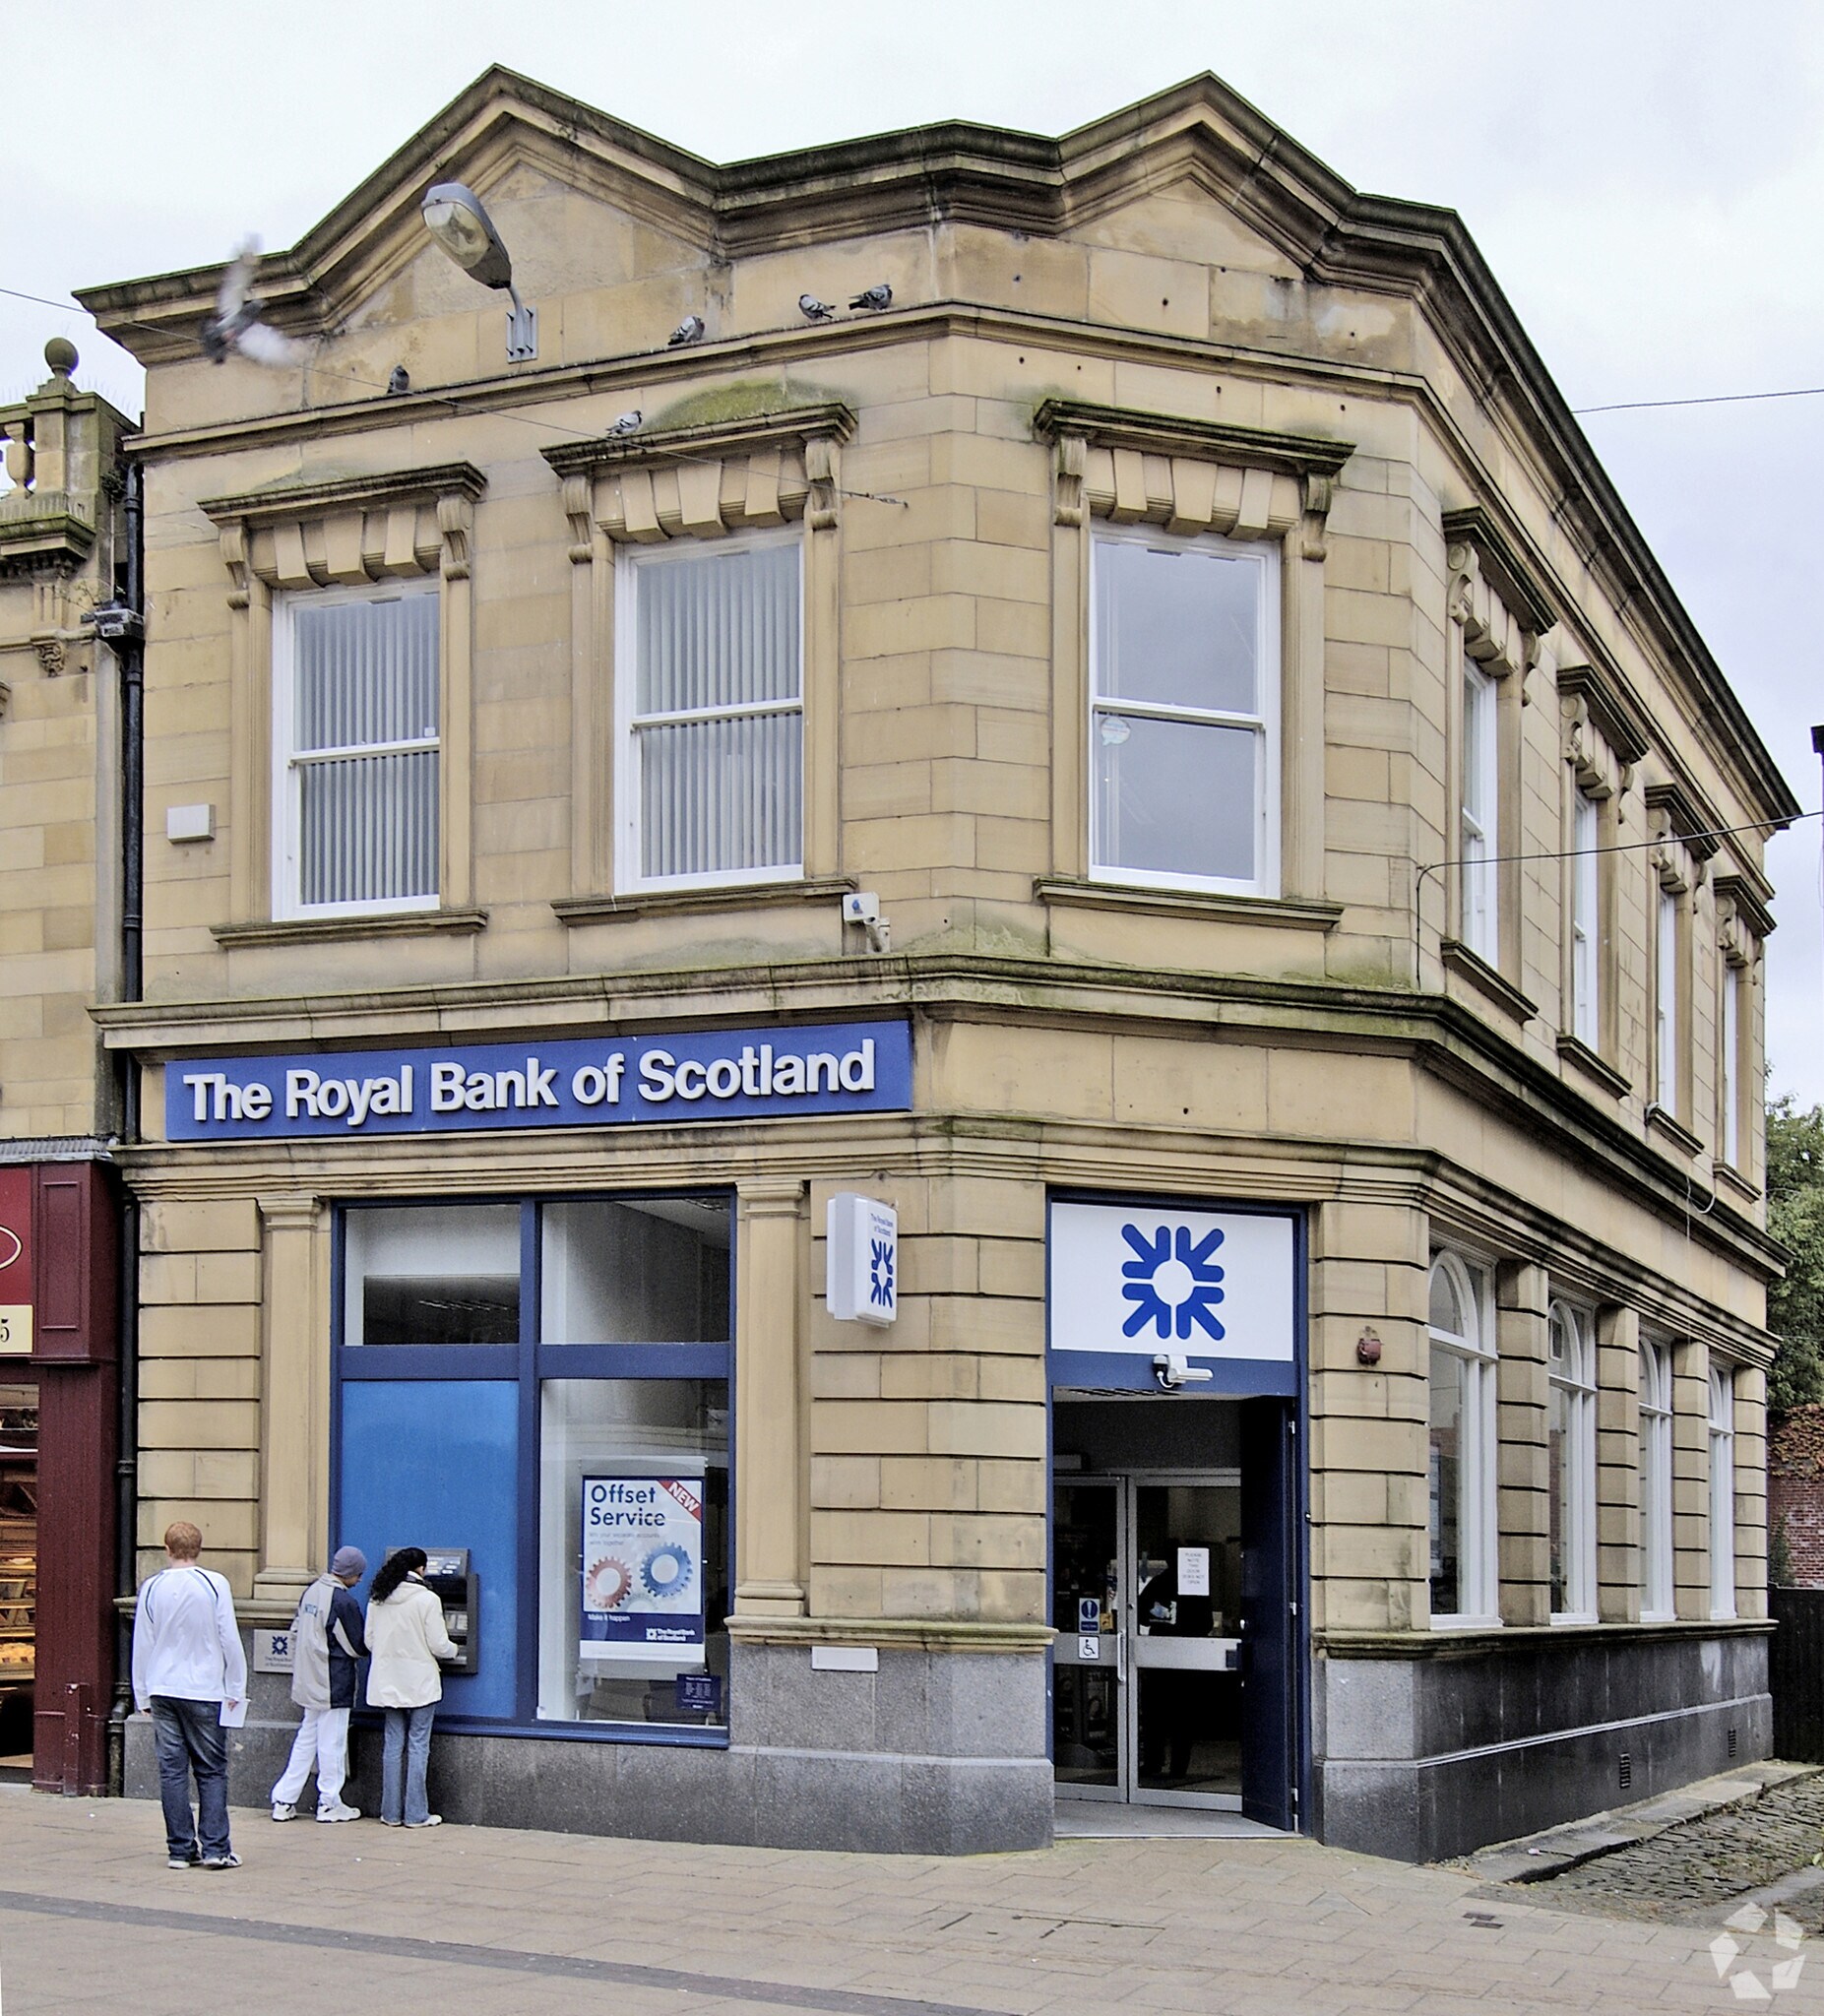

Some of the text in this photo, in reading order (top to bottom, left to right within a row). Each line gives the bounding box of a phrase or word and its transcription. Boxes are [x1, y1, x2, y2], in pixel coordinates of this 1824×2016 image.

[183, 1039, 875, 1126] The Royal Bank of Scotland
[591, 1483, 656, 1503] Offset
[668, 1480, 699, 1512] NEW
[591, 1506, 665, 1526] Service
